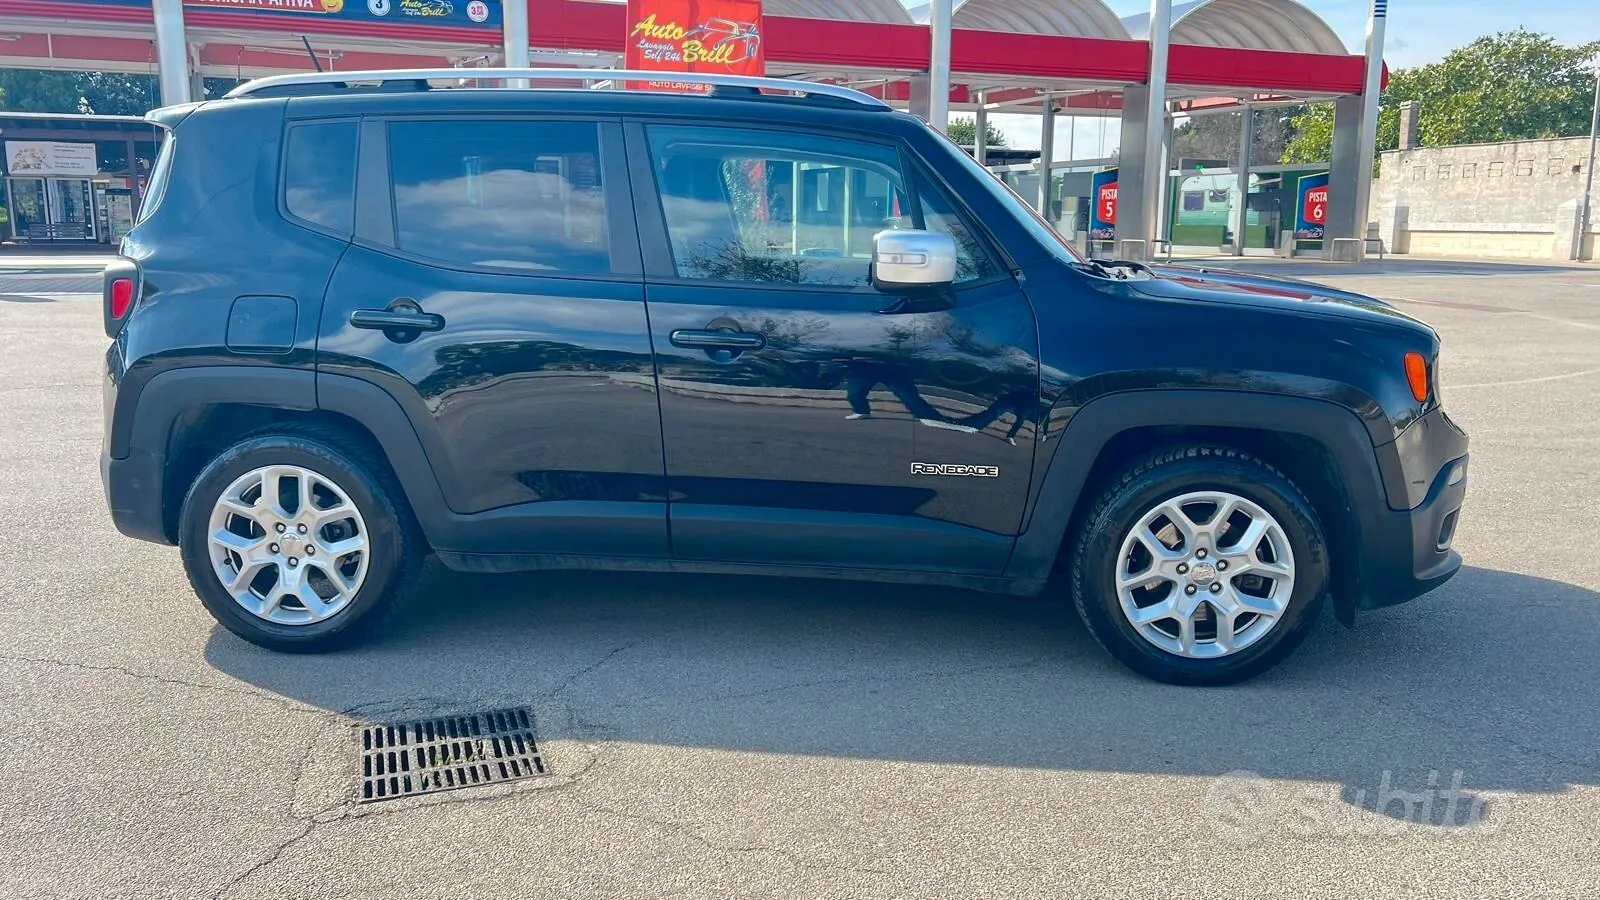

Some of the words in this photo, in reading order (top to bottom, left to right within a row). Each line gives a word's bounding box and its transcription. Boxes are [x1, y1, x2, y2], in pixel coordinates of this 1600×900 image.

[631, 13, 688, 41] Auto
[636, 38, 675, 53] Lavaggio
[681, 39, 738, 63] Brill
[644, 49, 662, 63] Self
[1101, 188, 1118, 200] PISTA
[1308, 191, 1327, 203] PISTA
[1105, 201, 1113, 217] 5
[1313, 204, 1323, 219] 6
[910, 462, 1000, 477] RENEGADE
